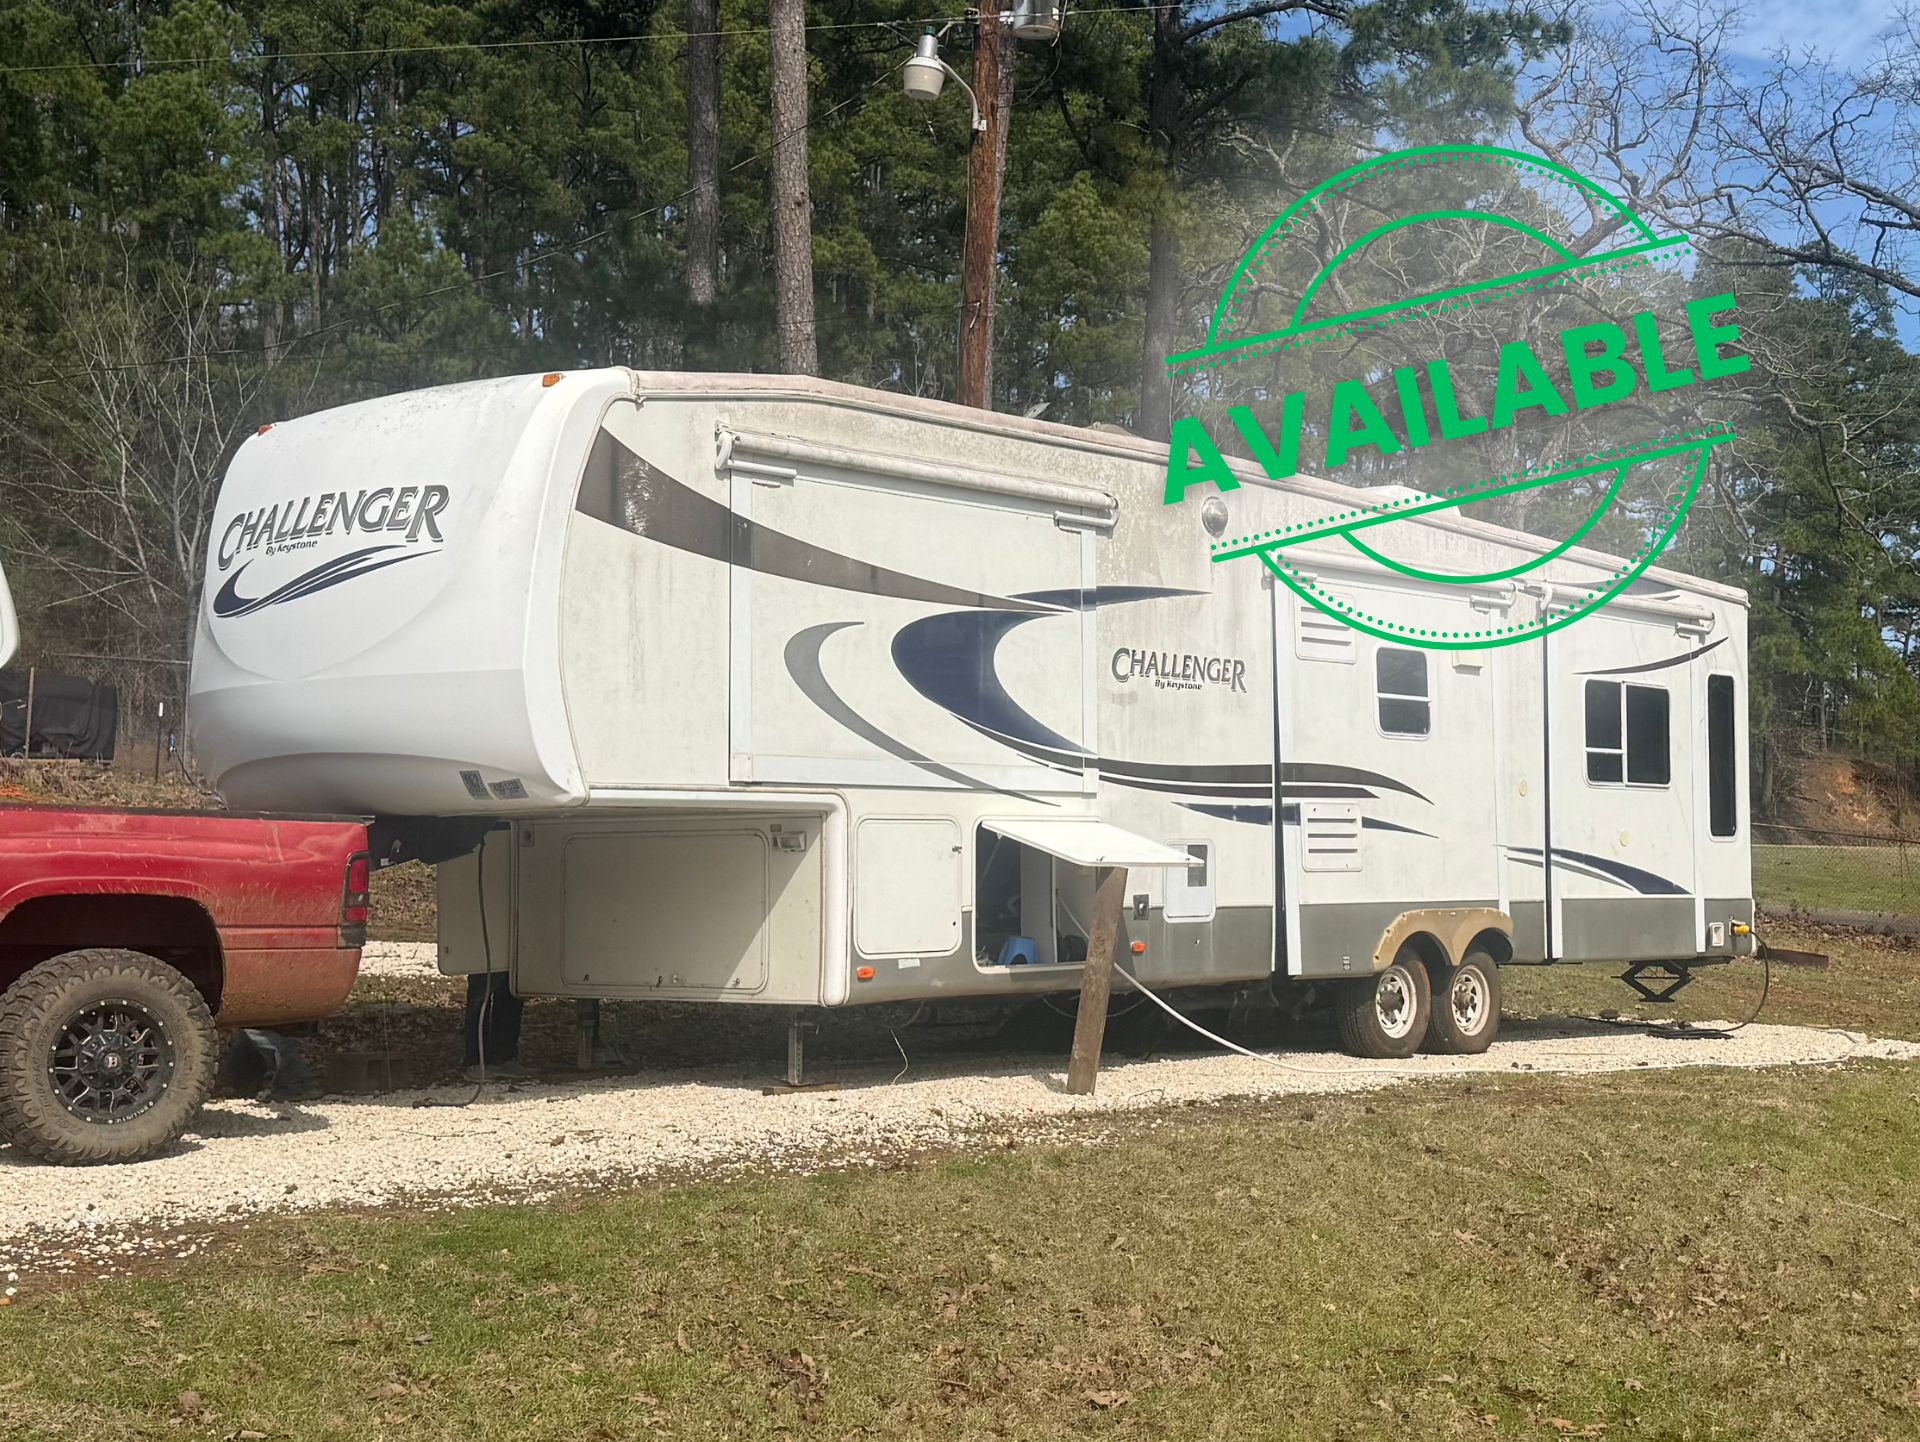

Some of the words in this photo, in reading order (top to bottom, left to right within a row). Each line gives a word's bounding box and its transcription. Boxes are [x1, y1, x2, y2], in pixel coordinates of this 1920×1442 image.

[218, 485, 450, 570] CHALLENGER
[1112, 647, 1247, 693] CHALLENGER
[1155, 679, 1165, 689] By
